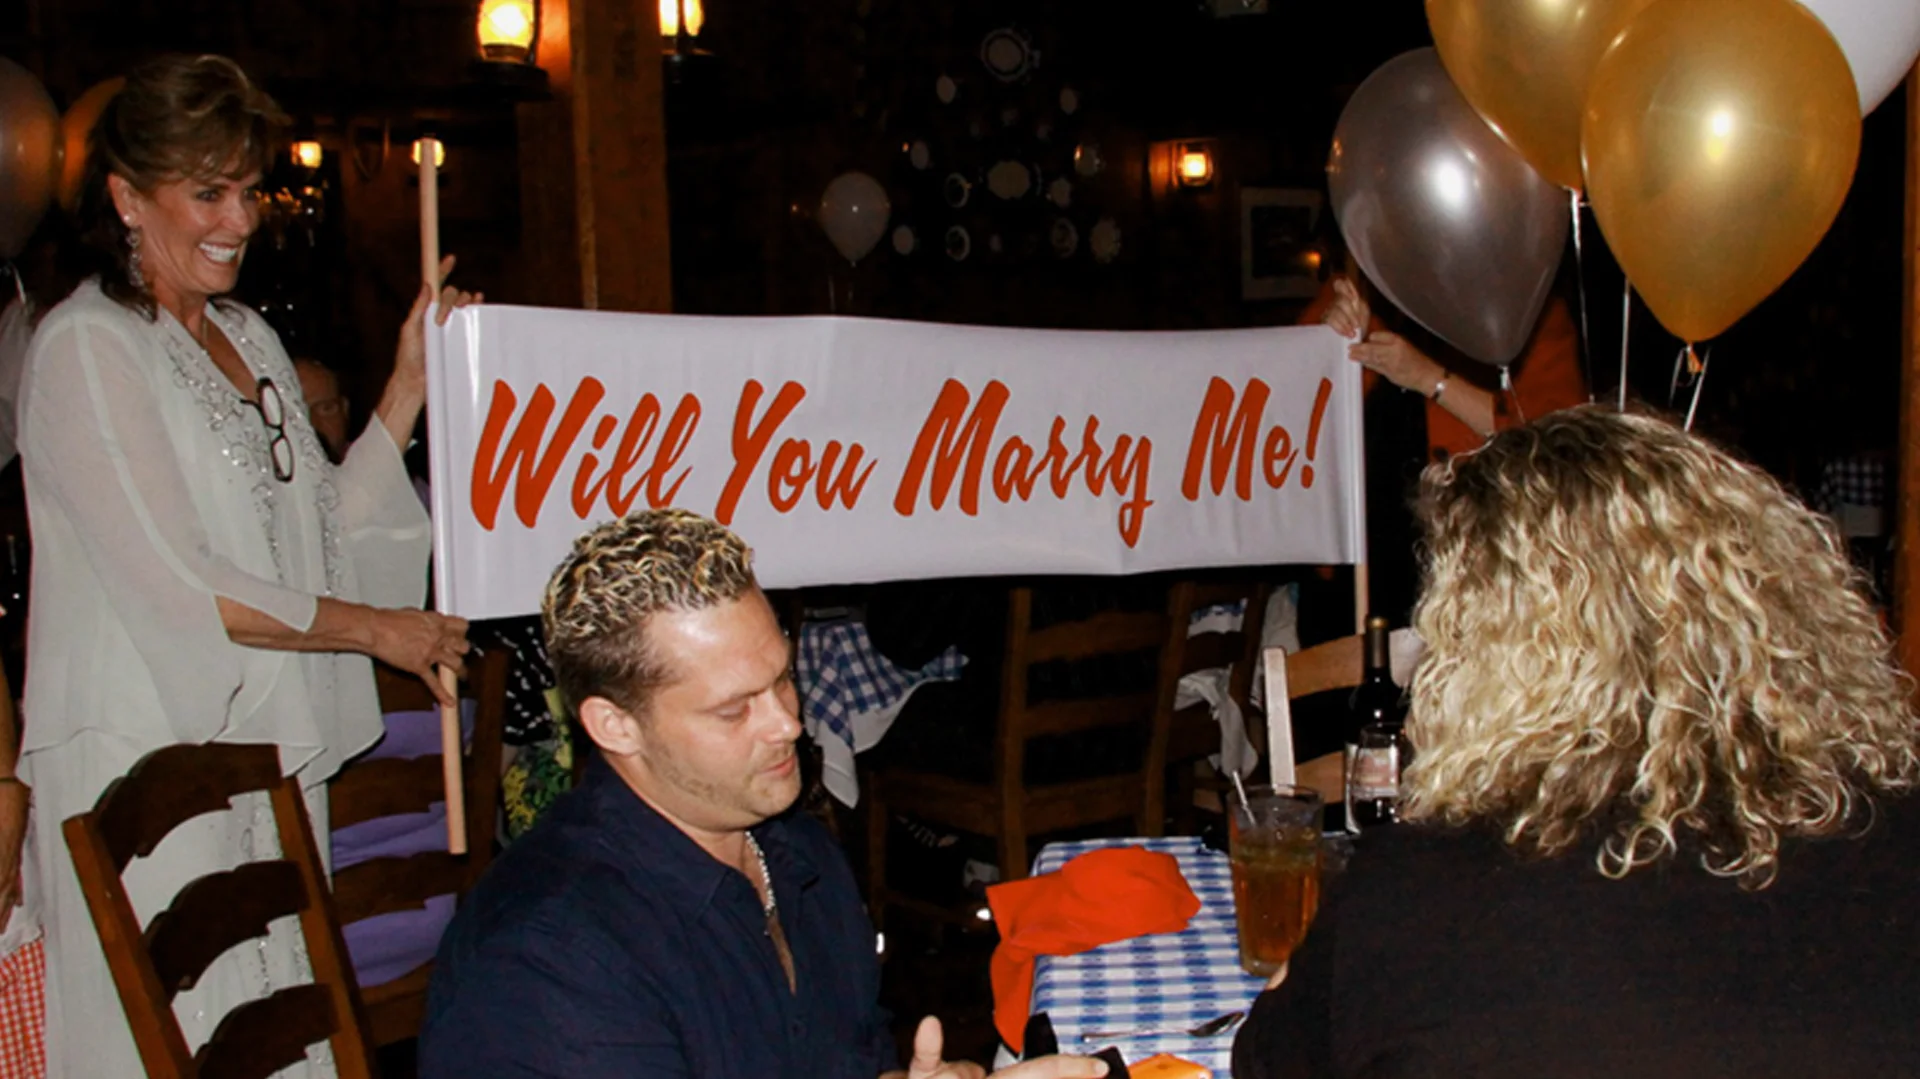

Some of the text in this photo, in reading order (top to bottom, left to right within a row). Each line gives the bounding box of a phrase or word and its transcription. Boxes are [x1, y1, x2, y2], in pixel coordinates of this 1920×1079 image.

[471, 377, 1332, 548] Will You Marry Me!
